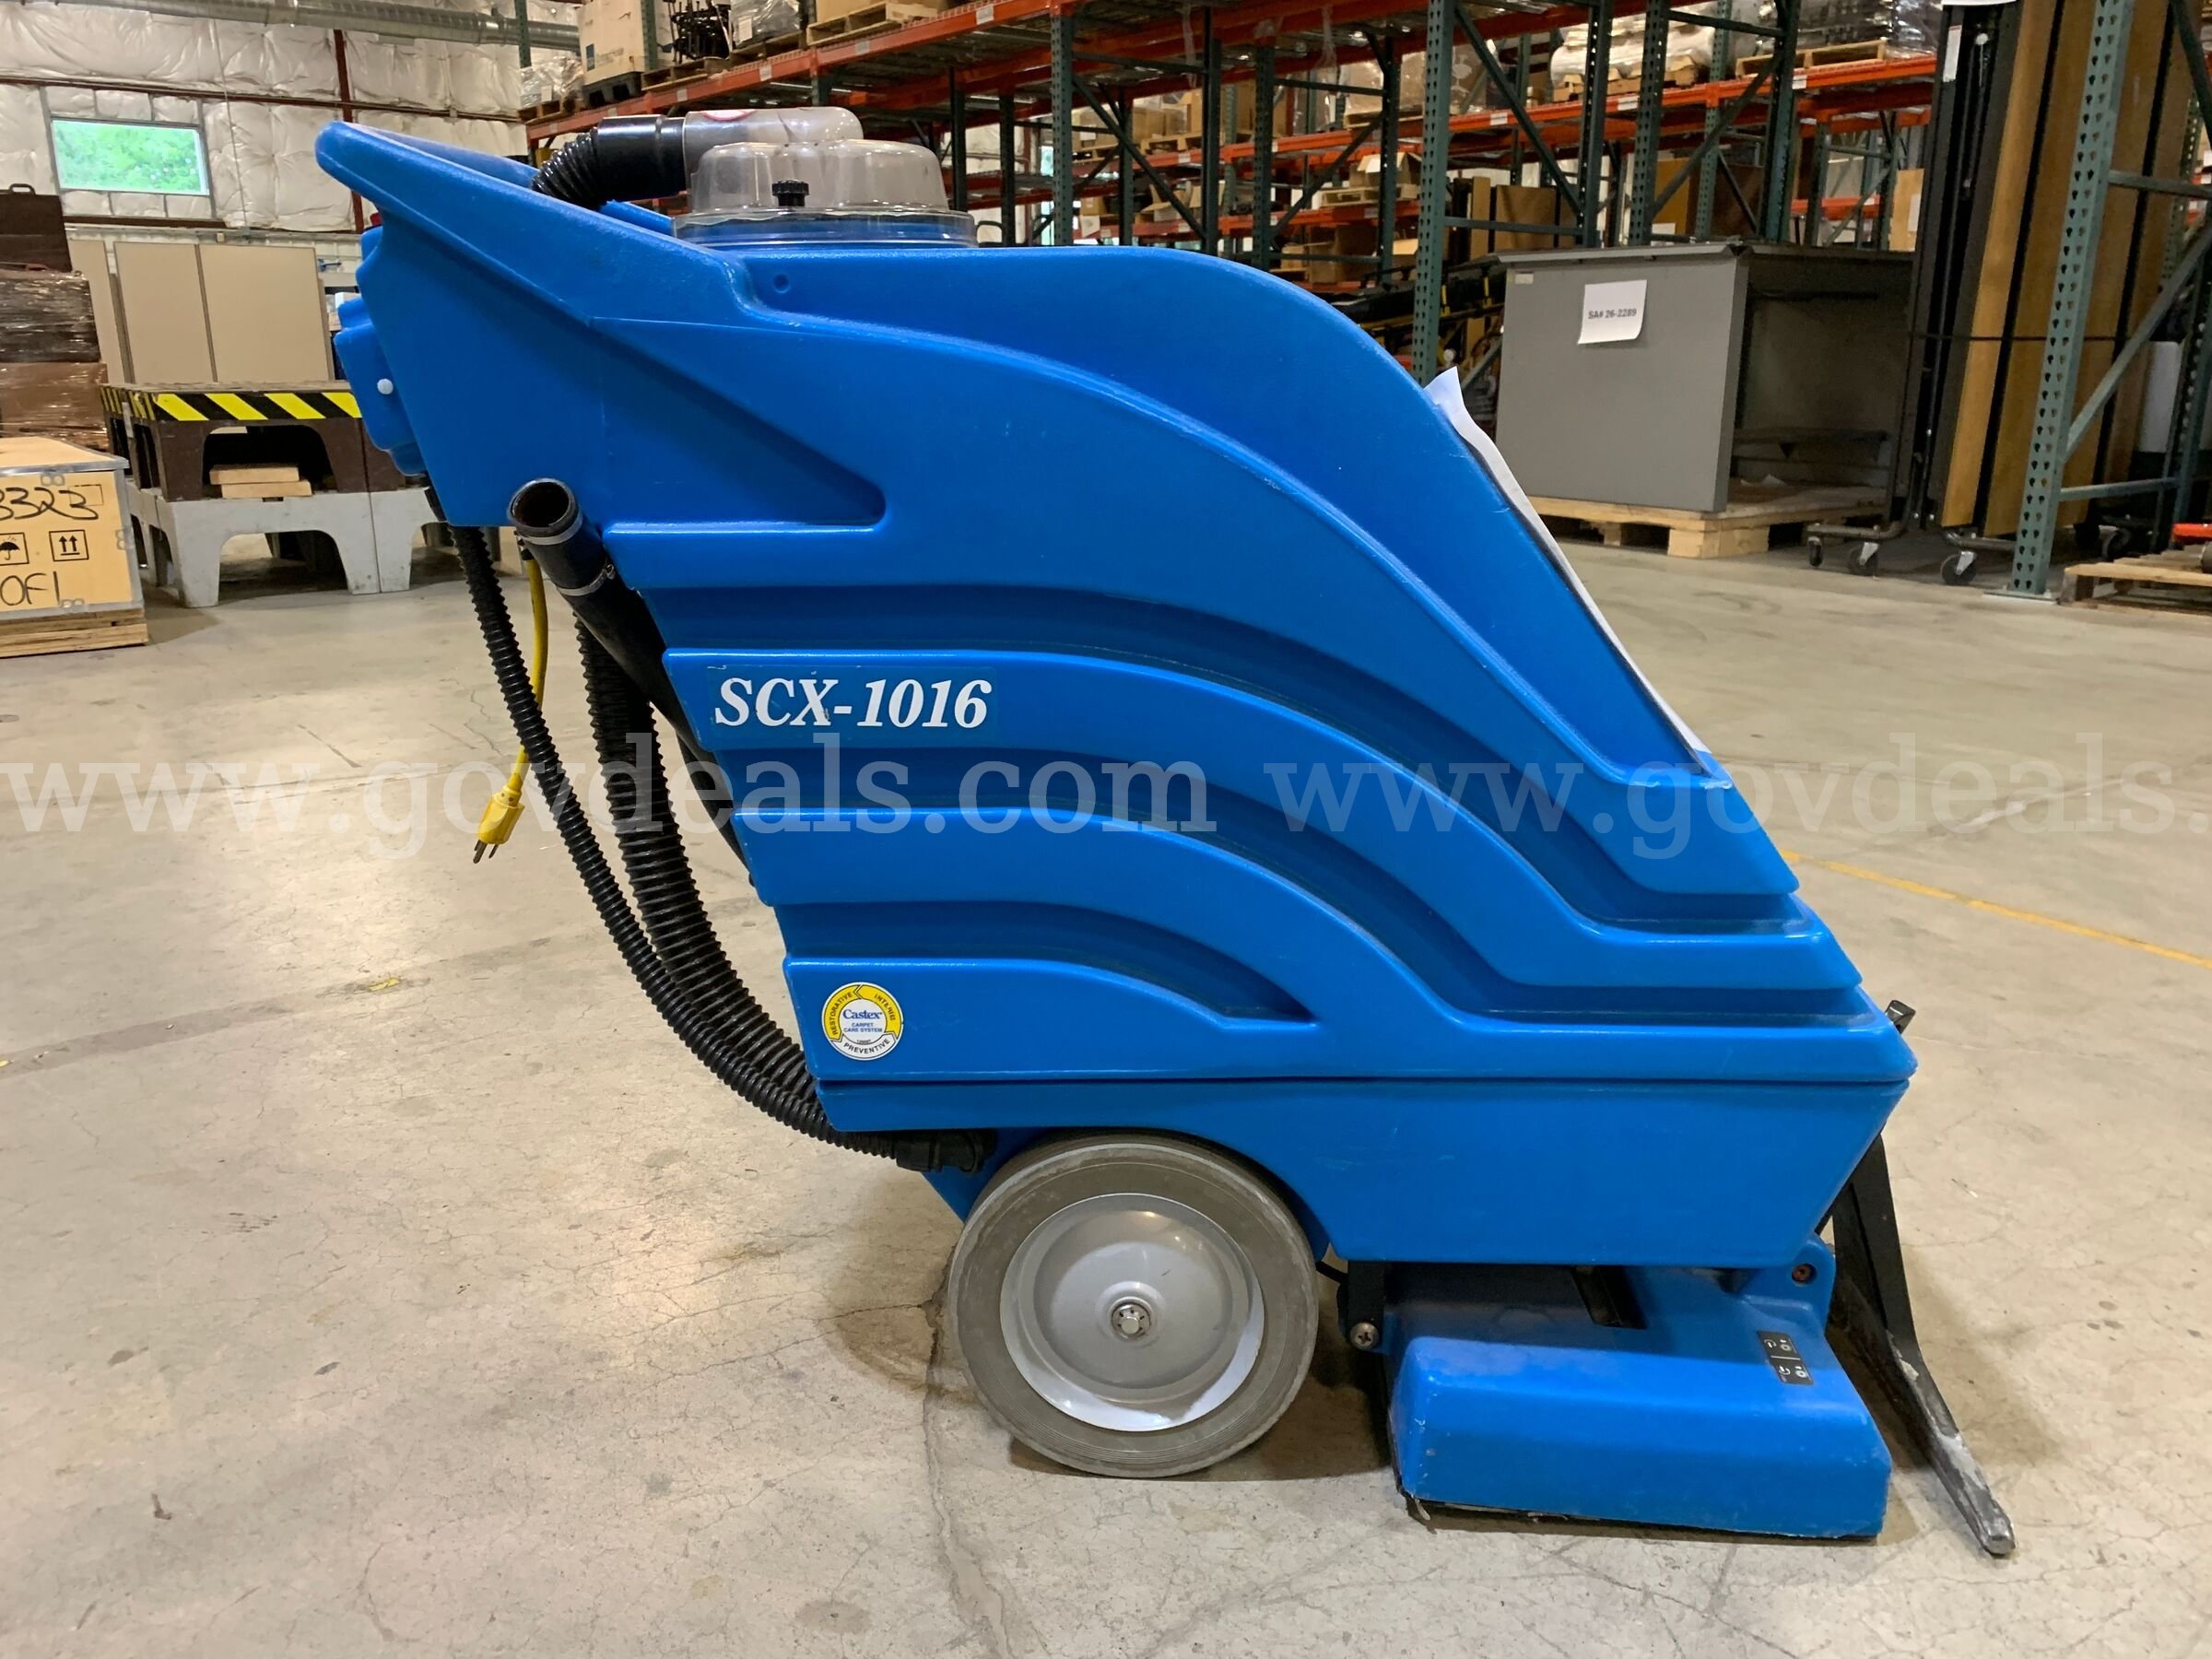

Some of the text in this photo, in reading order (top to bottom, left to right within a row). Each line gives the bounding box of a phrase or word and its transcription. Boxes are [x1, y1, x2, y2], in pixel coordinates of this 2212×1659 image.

[714, 677, 992, 729] SCX-1016
[830, 991, 853, 1036] RESTORATIVE
[842, 1009, 882, 1019] Castex
[843, 1038, 890, 1054] PREVENTIVE
